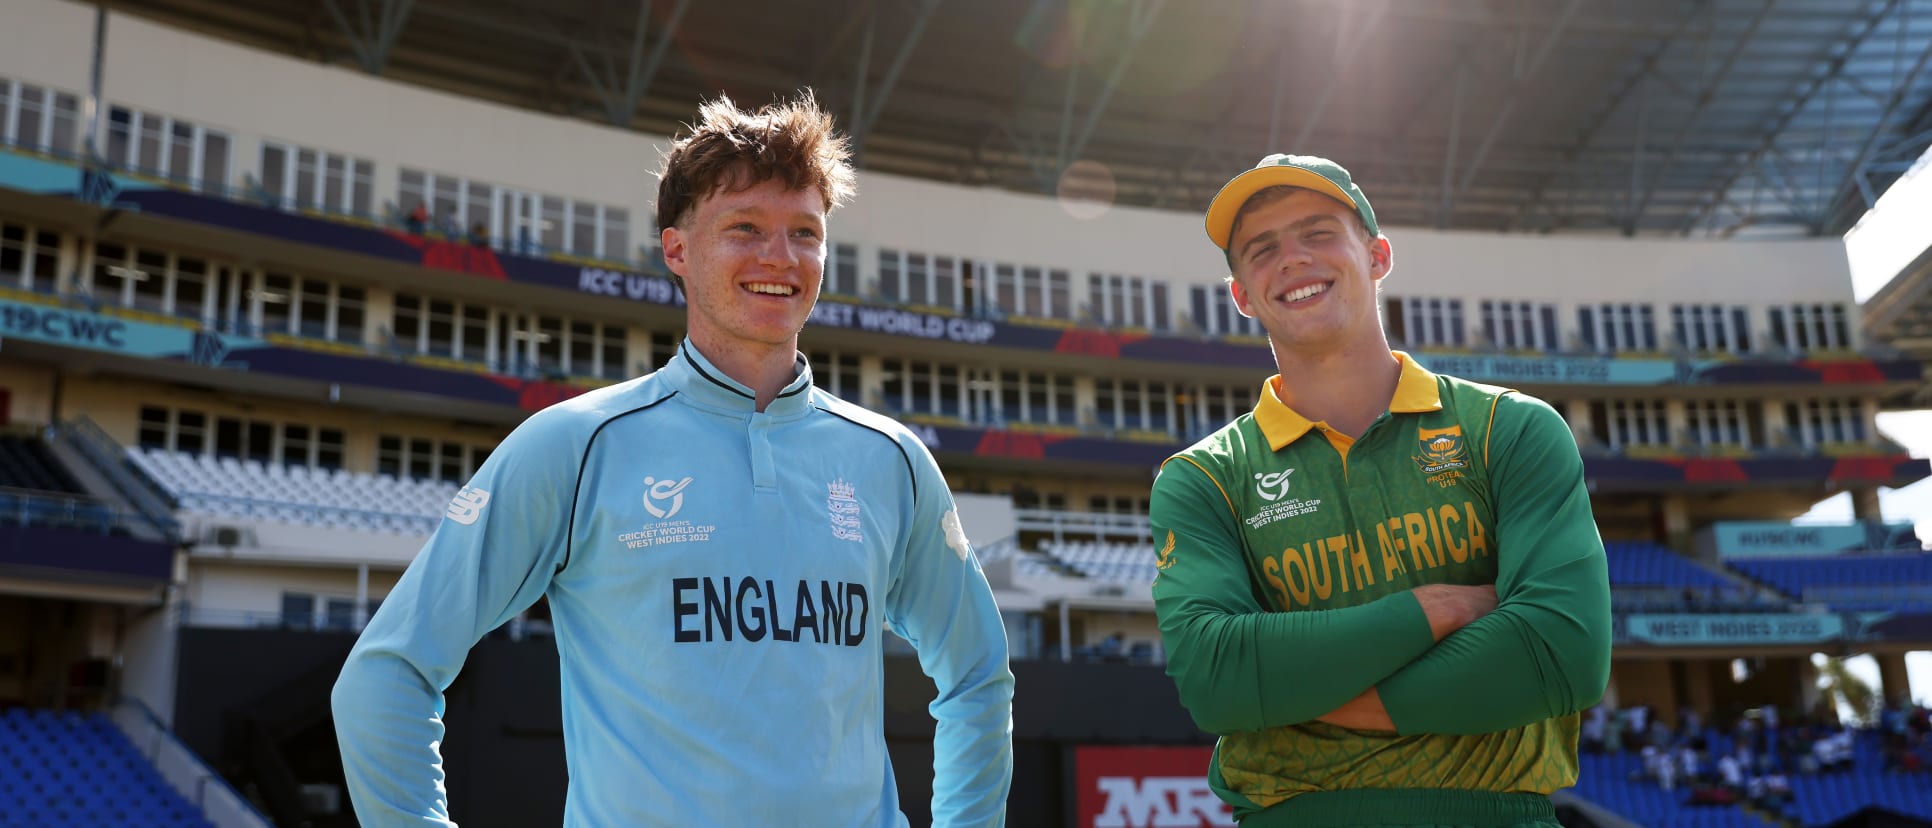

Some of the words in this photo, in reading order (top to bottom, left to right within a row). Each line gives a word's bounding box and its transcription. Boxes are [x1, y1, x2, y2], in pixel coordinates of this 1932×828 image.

[580, 268, 622, 296] ICC
[626, 275, 673, 303] U19
[858, 307, 945, 338] WORLD
[947, 318, 996, 343] CUP
[1439, 478, 1456, 489] U19
[1245, 509, 1274, 525] CRICKET
[1276, 503, 1304, 513] WORLD
[1305, 499, 1321, 508] CUP
[1252, 516, 1272, 530] WEST
[1273, 511, 1299, 521] INDIES
[1300, 506, 1317, 514] 2022
[618, 529, 658, 542] CRICKET
[659, 526, 695, 536] WORLD
[696, 525, 716, 533] CUP
[627, 538, 653, 550] WEST
[655, 534, 687, 545] INDIES
[689, 533, 710, 542] 2022
[1262, 529, 1375, 613] SOUTH
[1375, 501, 1489, 582] AFRICA
[673, 575, 869, 647] ENGLAND
[1650, 620, 1699, 638] WEST
[1704, 620, 1773, 638] INDIES
[1094, 775, 1237, 827] MR
